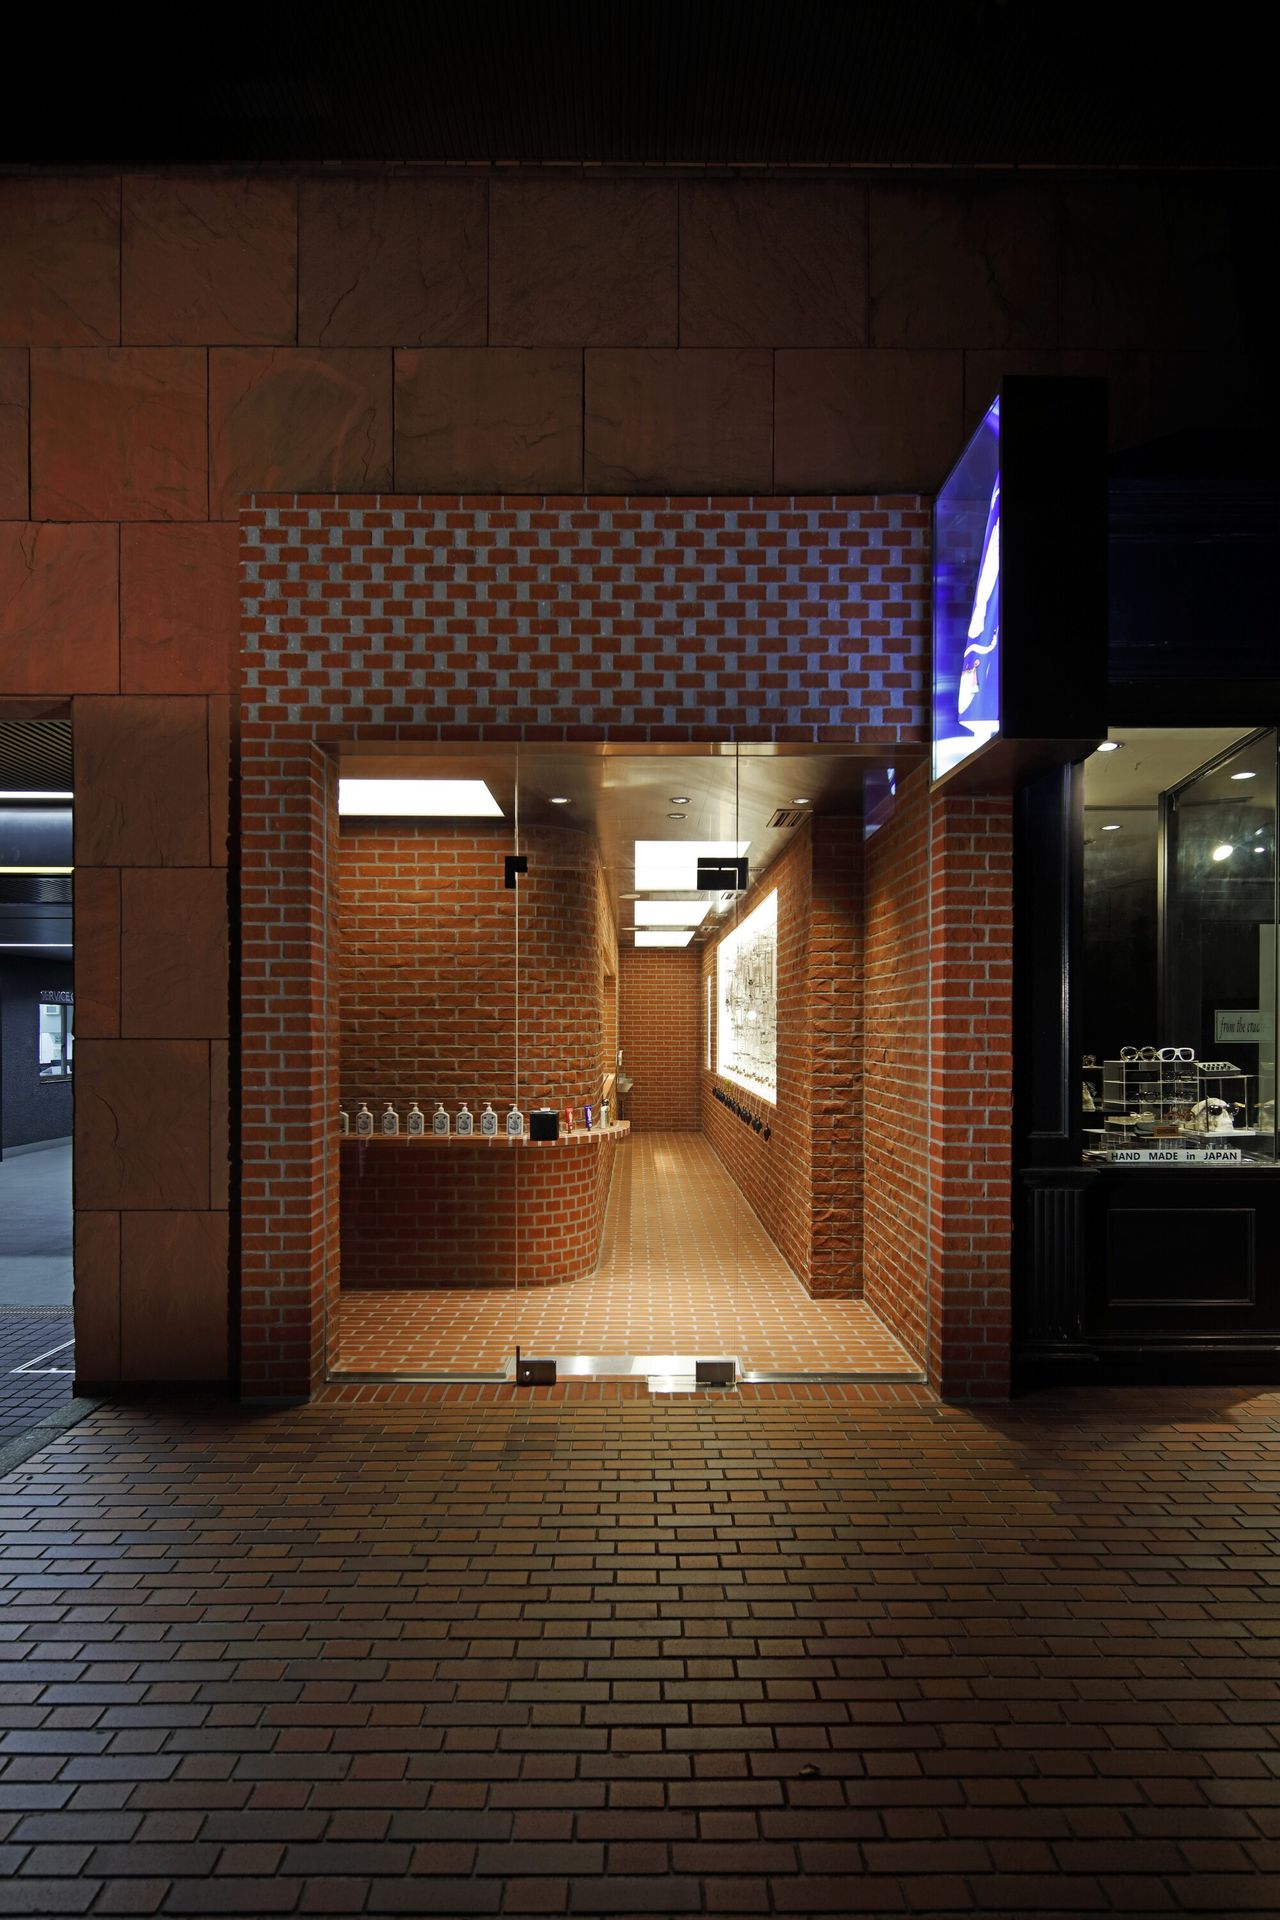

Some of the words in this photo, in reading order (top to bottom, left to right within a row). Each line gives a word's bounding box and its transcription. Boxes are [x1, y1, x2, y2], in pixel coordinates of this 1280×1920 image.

[40, 990, 70, 1002] SERVICE
[1111, 1152, 1141, 1161] HAND
[1148, 1152, 1178, 1161] MADE
[1186, 1152, 1196, 1161] in
[1203, 1152, 1237, 1161] JAPAN
